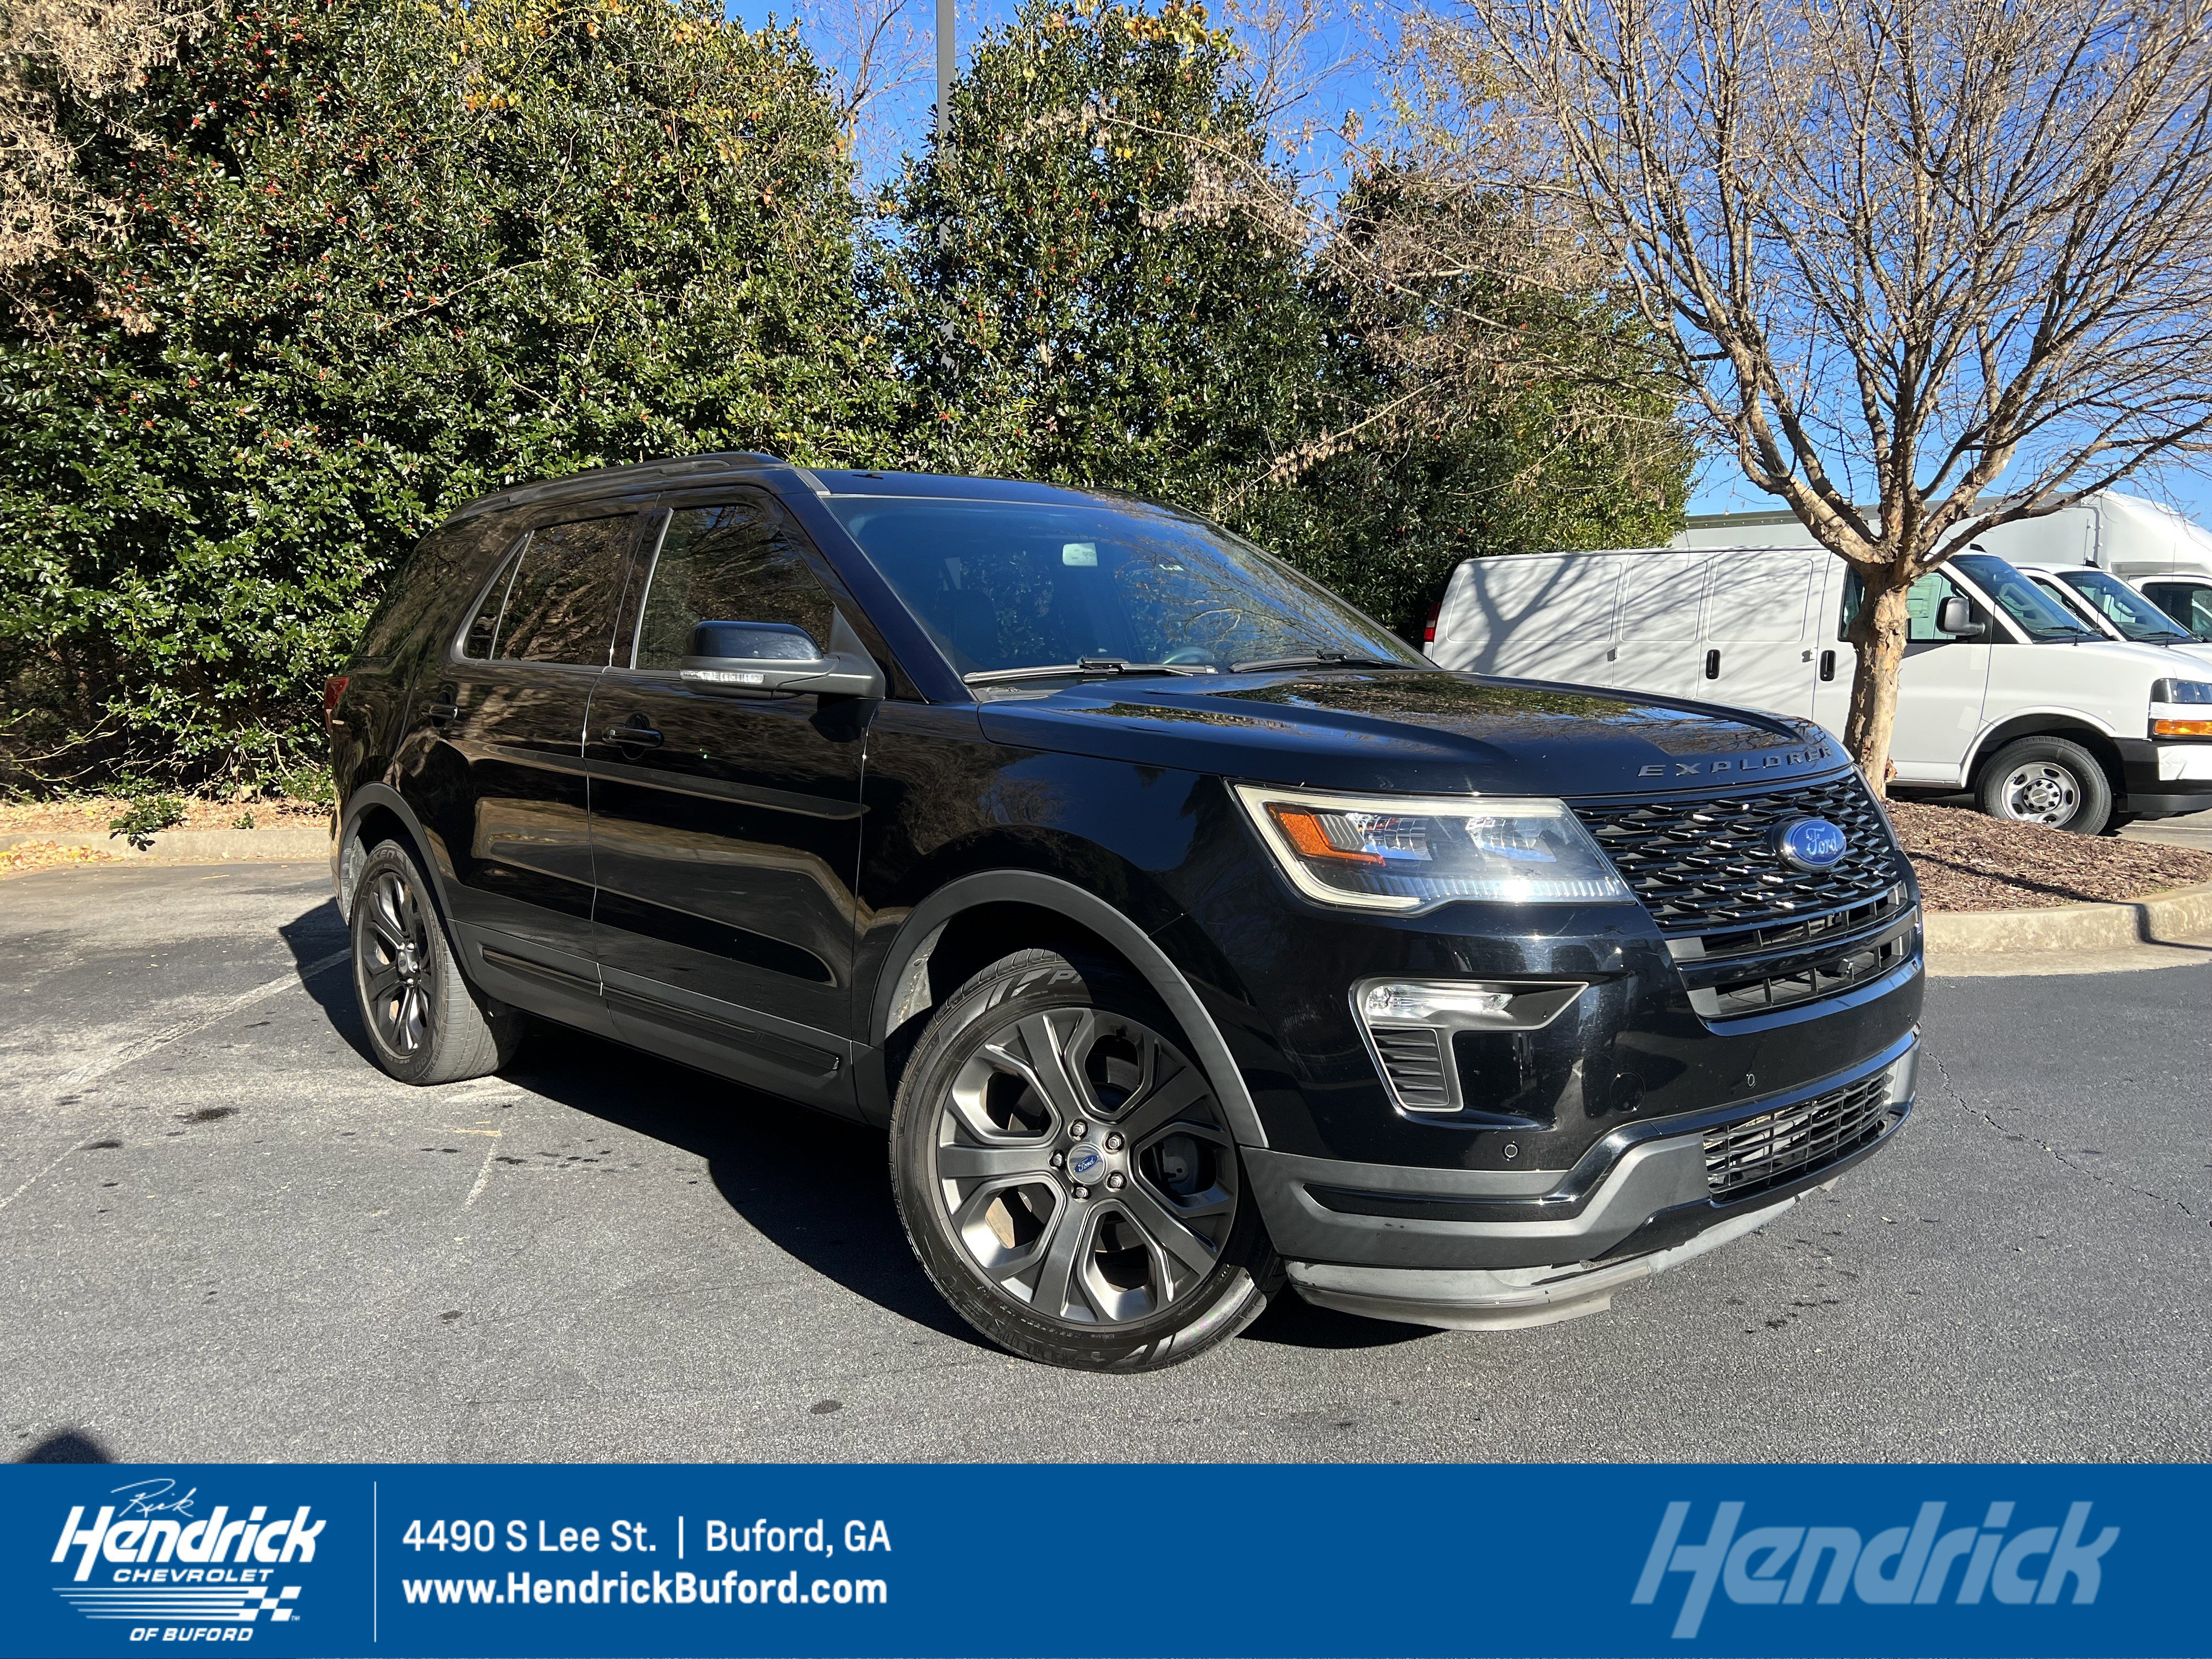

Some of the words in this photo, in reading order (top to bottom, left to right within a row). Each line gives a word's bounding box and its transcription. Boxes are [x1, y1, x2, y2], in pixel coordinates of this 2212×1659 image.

[1638, 747, 1832, 777] EXPLORER
[1807, 826, 1839, 856] Ford
[1078, 1157, 1095, 1172] Ford
